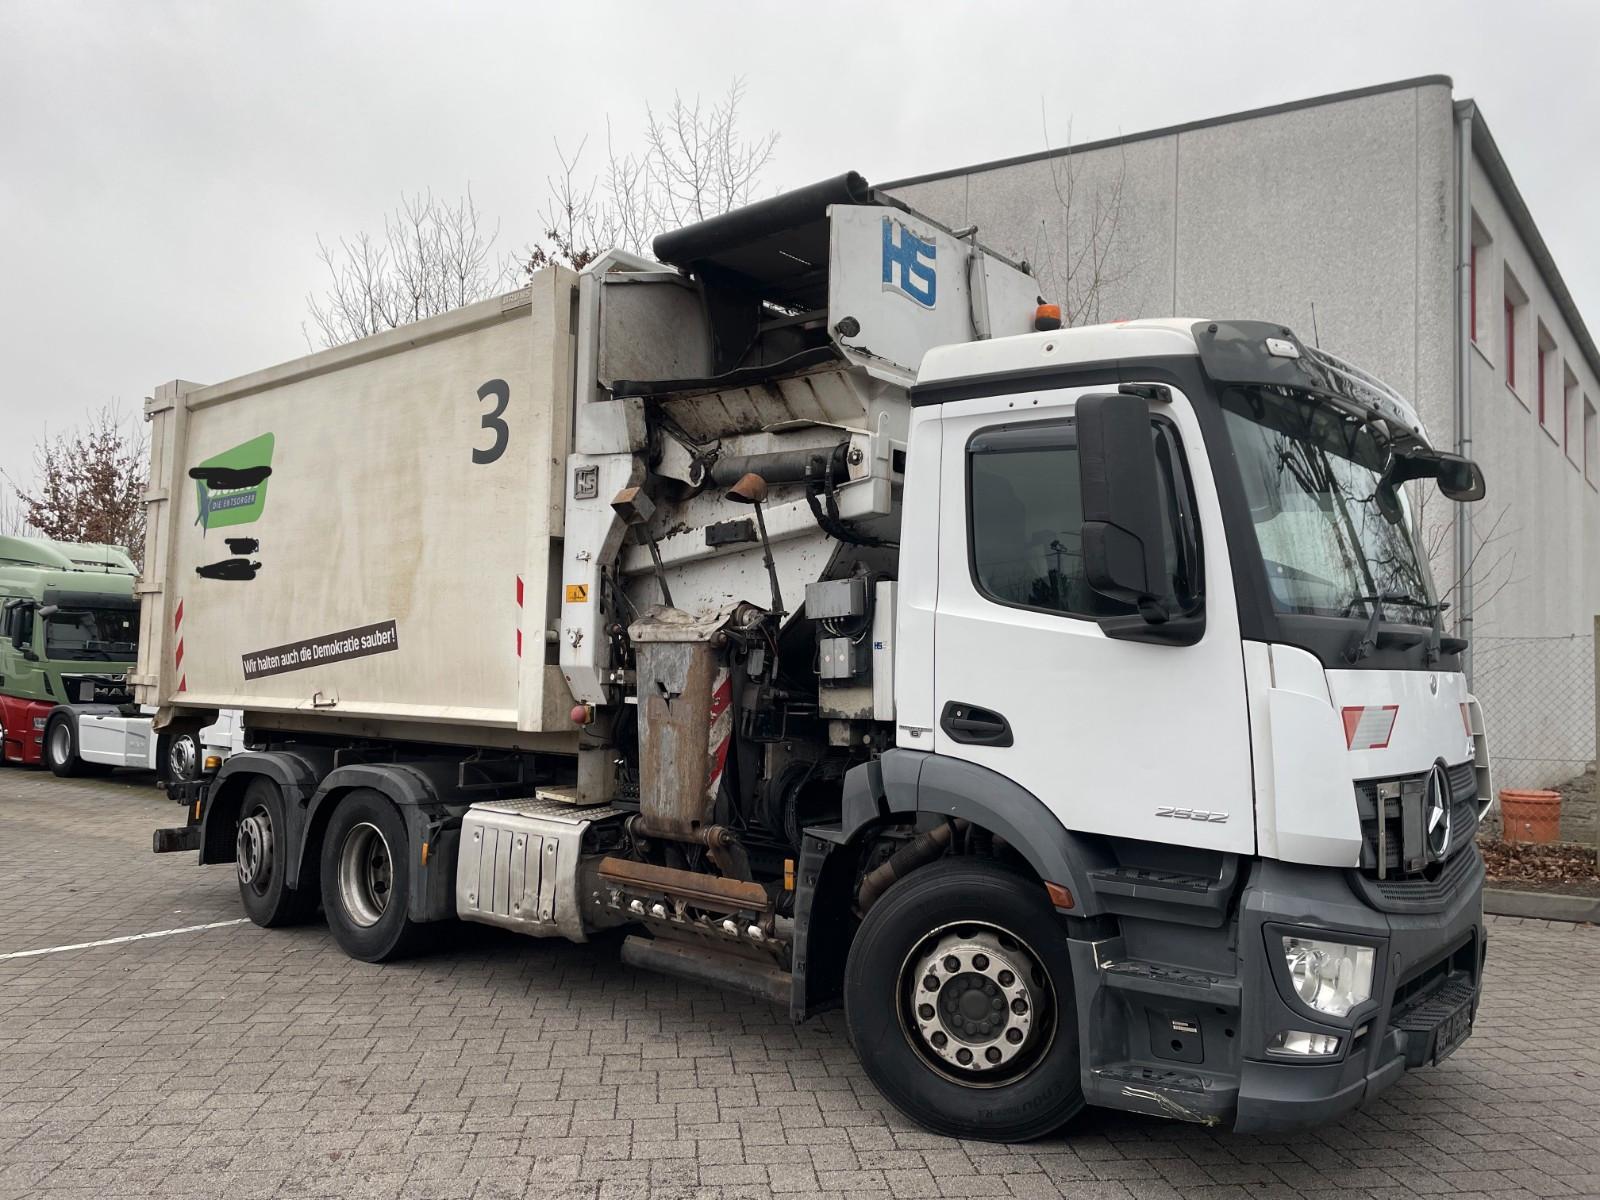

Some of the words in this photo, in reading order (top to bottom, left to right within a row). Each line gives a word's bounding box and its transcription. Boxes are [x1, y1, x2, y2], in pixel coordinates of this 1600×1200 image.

[882, 216, 936, 307] HS
[472, 379, 510, 464] 3
[212, 498, 222, 510] DIE
[223, 494, 256, 508] ENTSORGER
[243, 658, 257, 674] Wir
[257, 655, 280, 671] halten
[280, 648, 300, 666] auch
[300, 646, 312, 662] die
[312, 635, 360, 660] Demokratie
[360, 627, 395, 649] sauber!
[1155, 806, 1229, 824] 2532
